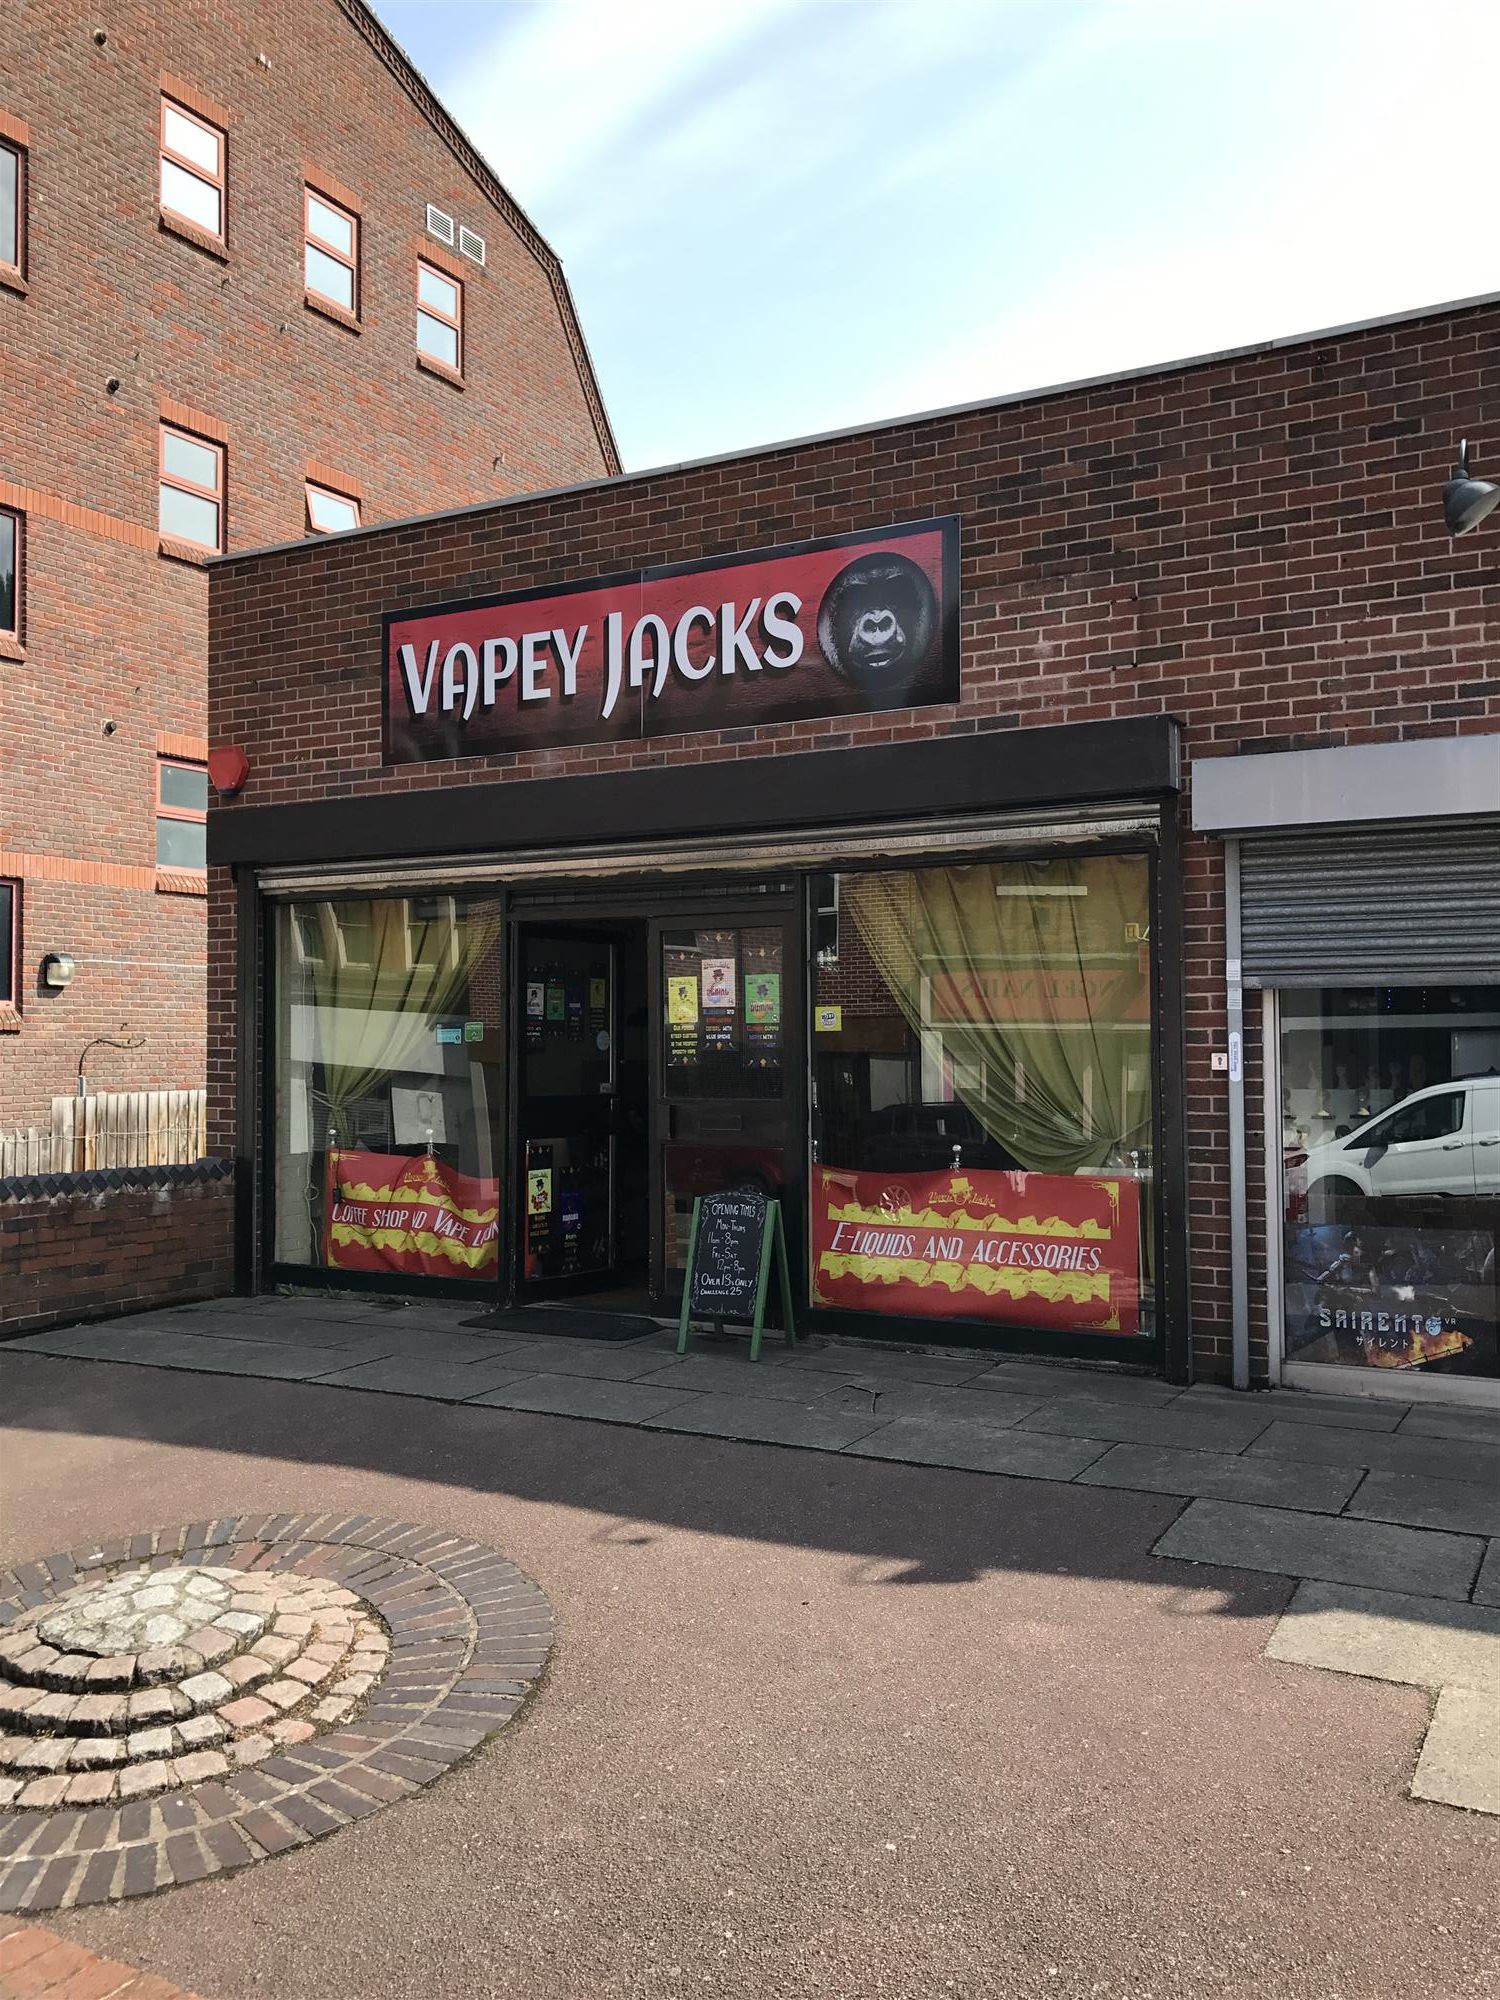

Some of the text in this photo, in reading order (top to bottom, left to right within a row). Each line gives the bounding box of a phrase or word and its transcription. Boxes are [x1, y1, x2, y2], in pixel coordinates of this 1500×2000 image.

[401, 592, 804, 720] VAPEY JACKS
[711, 1203, 756, 1218] OPENING TIMES
[372, 1209, 409, 1228] SHOP
[433, 1209, 469, 1242] VAPE
[831, 1222, 1102, 1271] E-LIQUIDS AND ACCESSORIES
[734, 1279, 753, 1288] ONLY
[730, 1286, 743, 1296] 25
[1444, 1317, 1456, 1325] VR
[1355, 1336, 1409, 1349] サイレント
